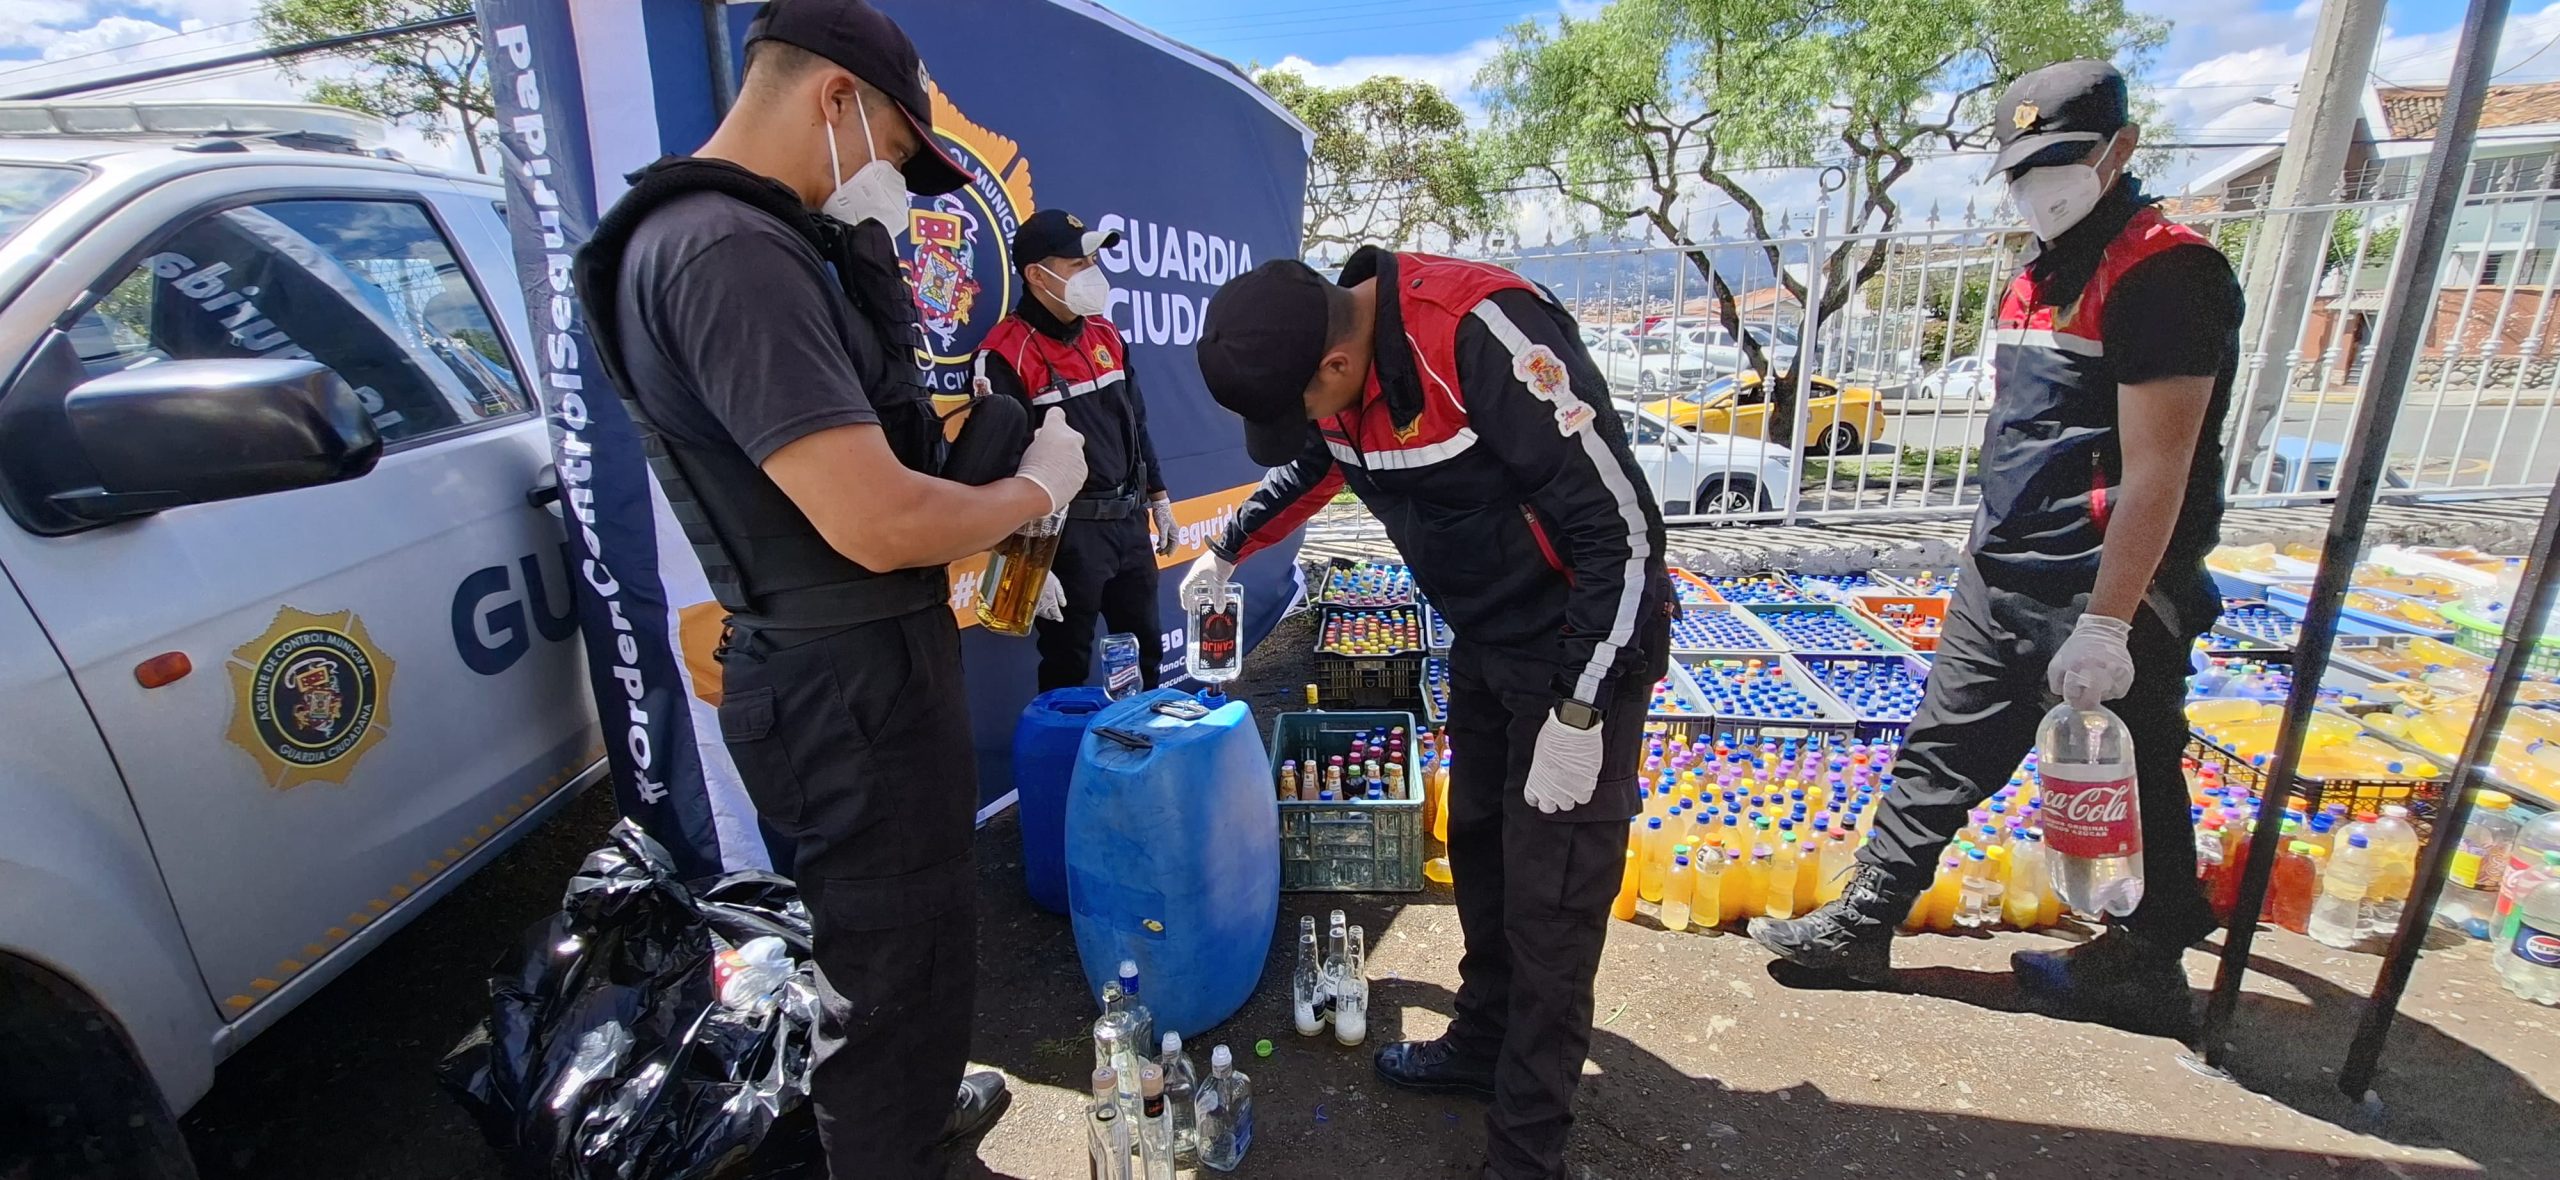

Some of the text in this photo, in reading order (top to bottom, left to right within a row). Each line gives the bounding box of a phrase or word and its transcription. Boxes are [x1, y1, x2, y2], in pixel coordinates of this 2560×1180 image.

[1097, 213, 1253, 286] GUARDIA
[255, 633, 372, 722] AGENTE DE CONTROL MUNICIPAL
[279, 703, 373, 763] GUARDIA CIUDADANA
